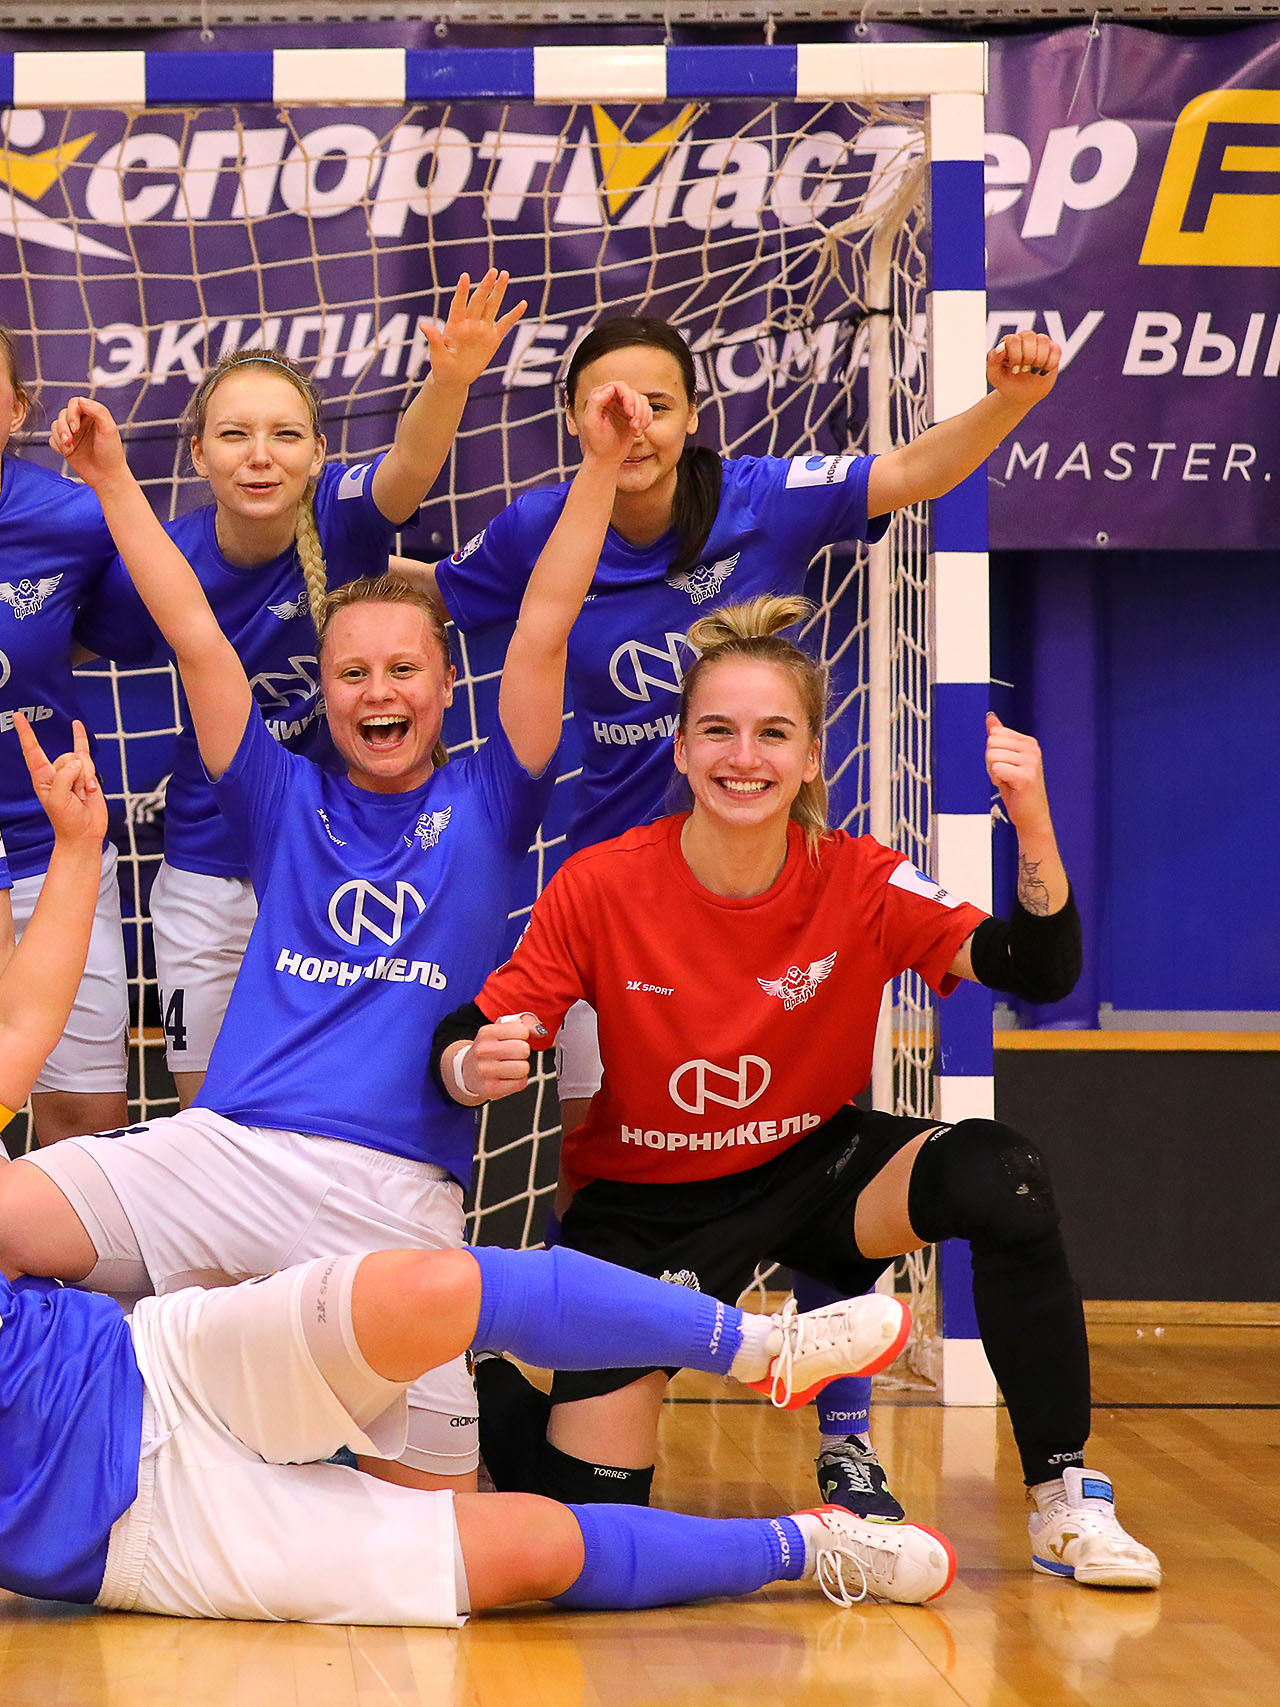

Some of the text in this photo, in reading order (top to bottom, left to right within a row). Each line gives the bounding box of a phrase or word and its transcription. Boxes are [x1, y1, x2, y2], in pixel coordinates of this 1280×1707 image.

[641, 983, 675, 996] SPORT
[621, 1112, 822, 1152] НОРНИКЕЛЬ
[593, 1467, 628, 1480] TORRES
